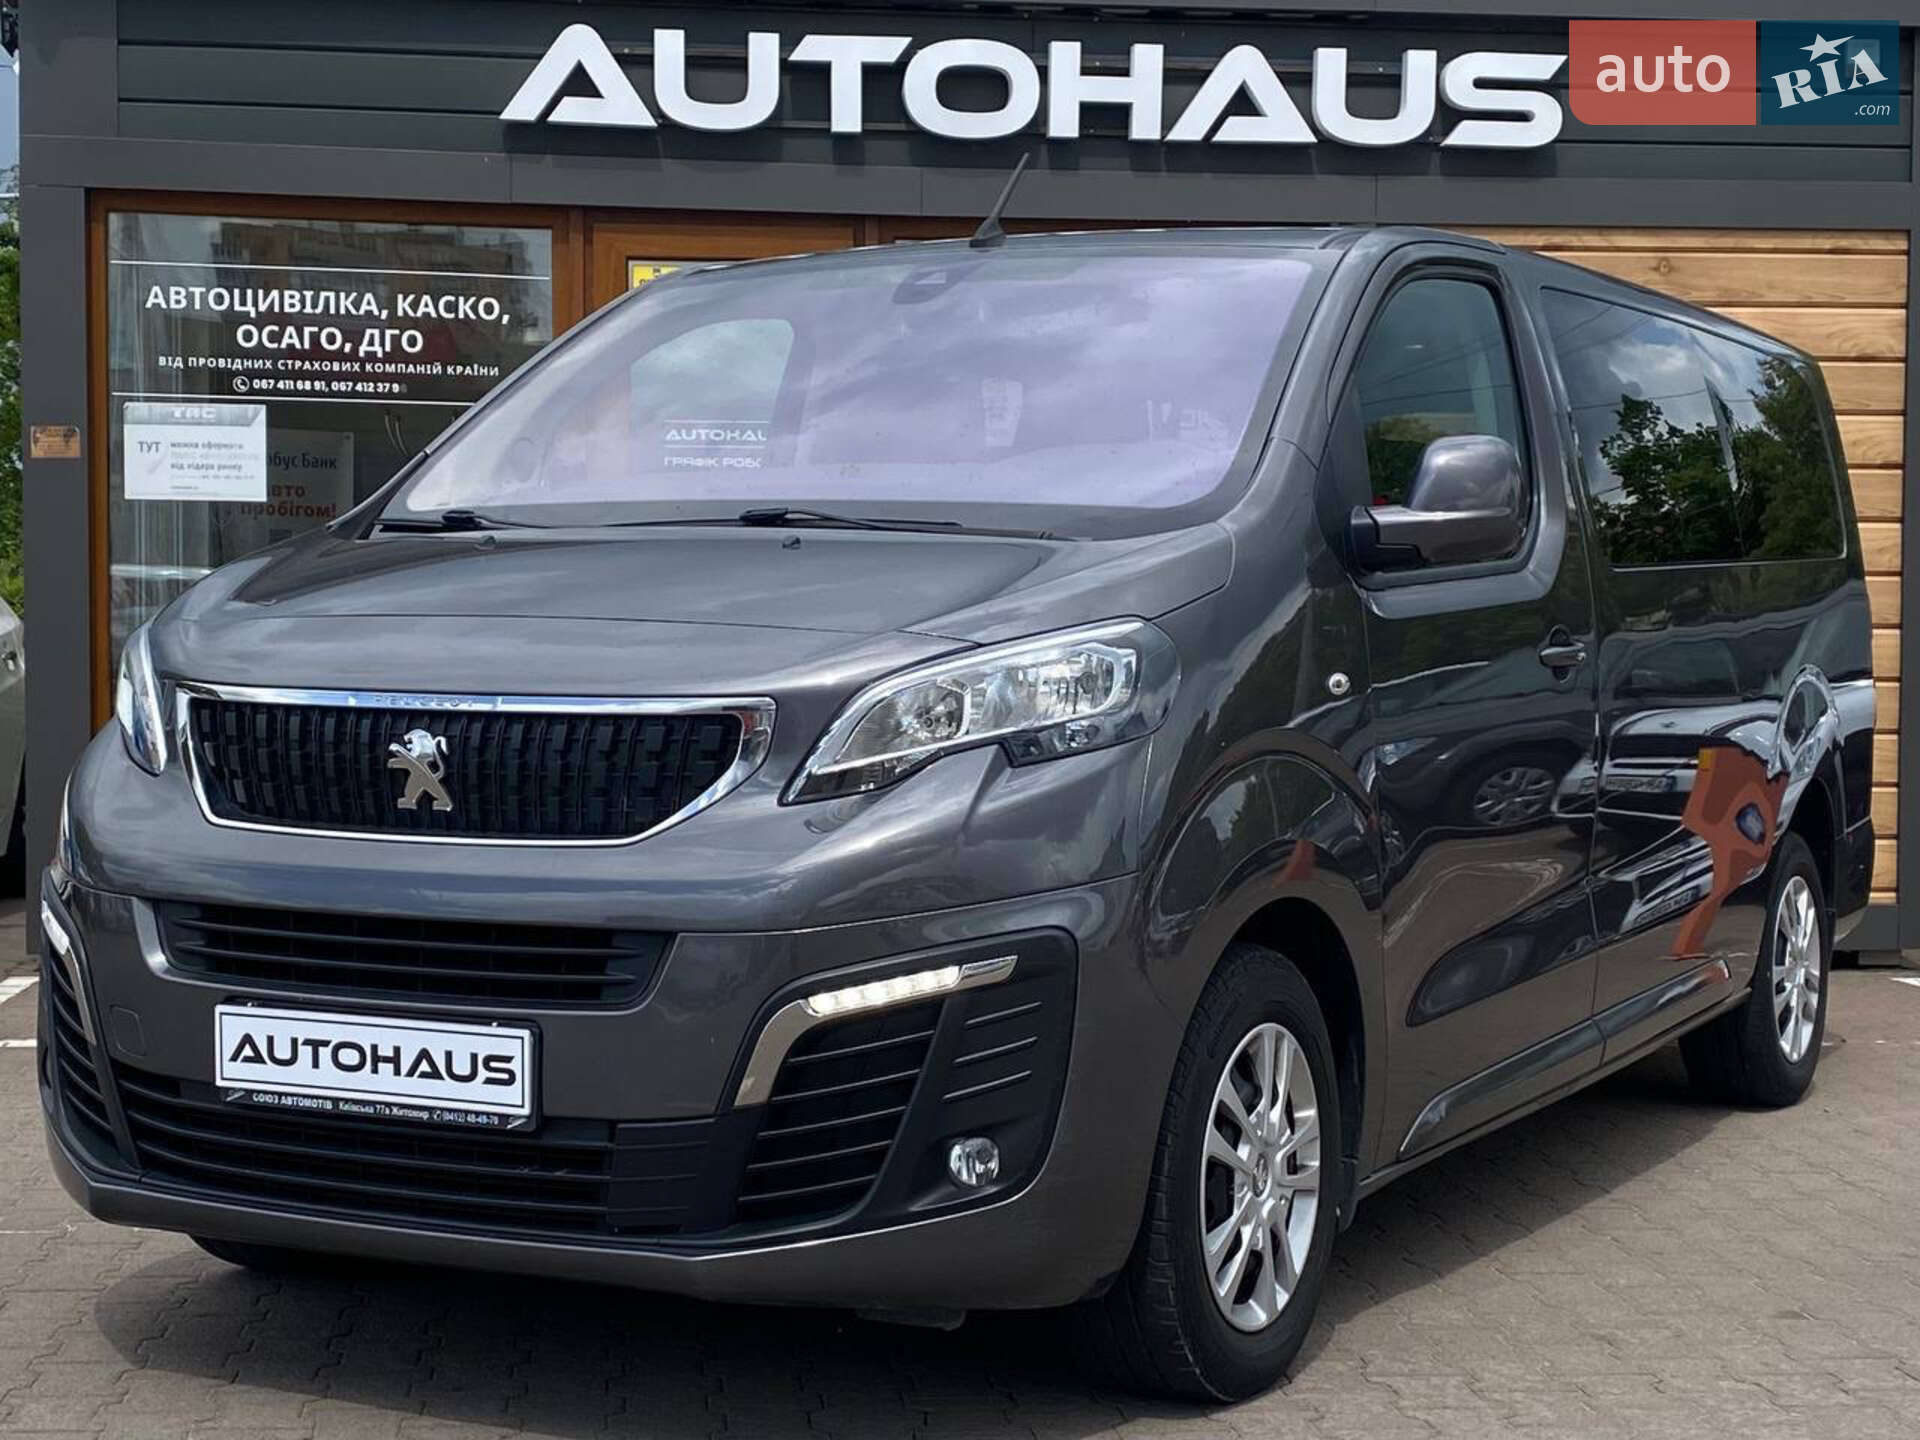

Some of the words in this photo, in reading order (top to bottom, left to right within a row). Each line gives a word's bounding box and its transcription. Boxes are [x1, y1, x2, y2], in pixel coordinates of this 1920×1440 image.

[499, 23, 1568, 149] AUTOHAUS
[145, 285, 389, 320] АВТОЦИВІЛКА,
[396, 293, 510, 325] КАСКО,
[236, 323, 353, 354] ОСАГО,
[358, 328, 424, 358] ДГО
[158, 356, 184, 370] ВІД
[188, 357, 273, 371] ПРОВІДНИХ
[277, 359, 361, 372] СТРАХОВИХ
[365, 361, 443, 375] КОМПАНІЙ
[446, 363, 500, 377] КРАЇНИ
[252, 378, 274, 390] 067
[355, 381, 375, 392] 412
[376, 382, 390, 393] 37
[138, 441, 162, 453] ТУТ
[228, 1032, 517, 1086] AUTOHAUS
